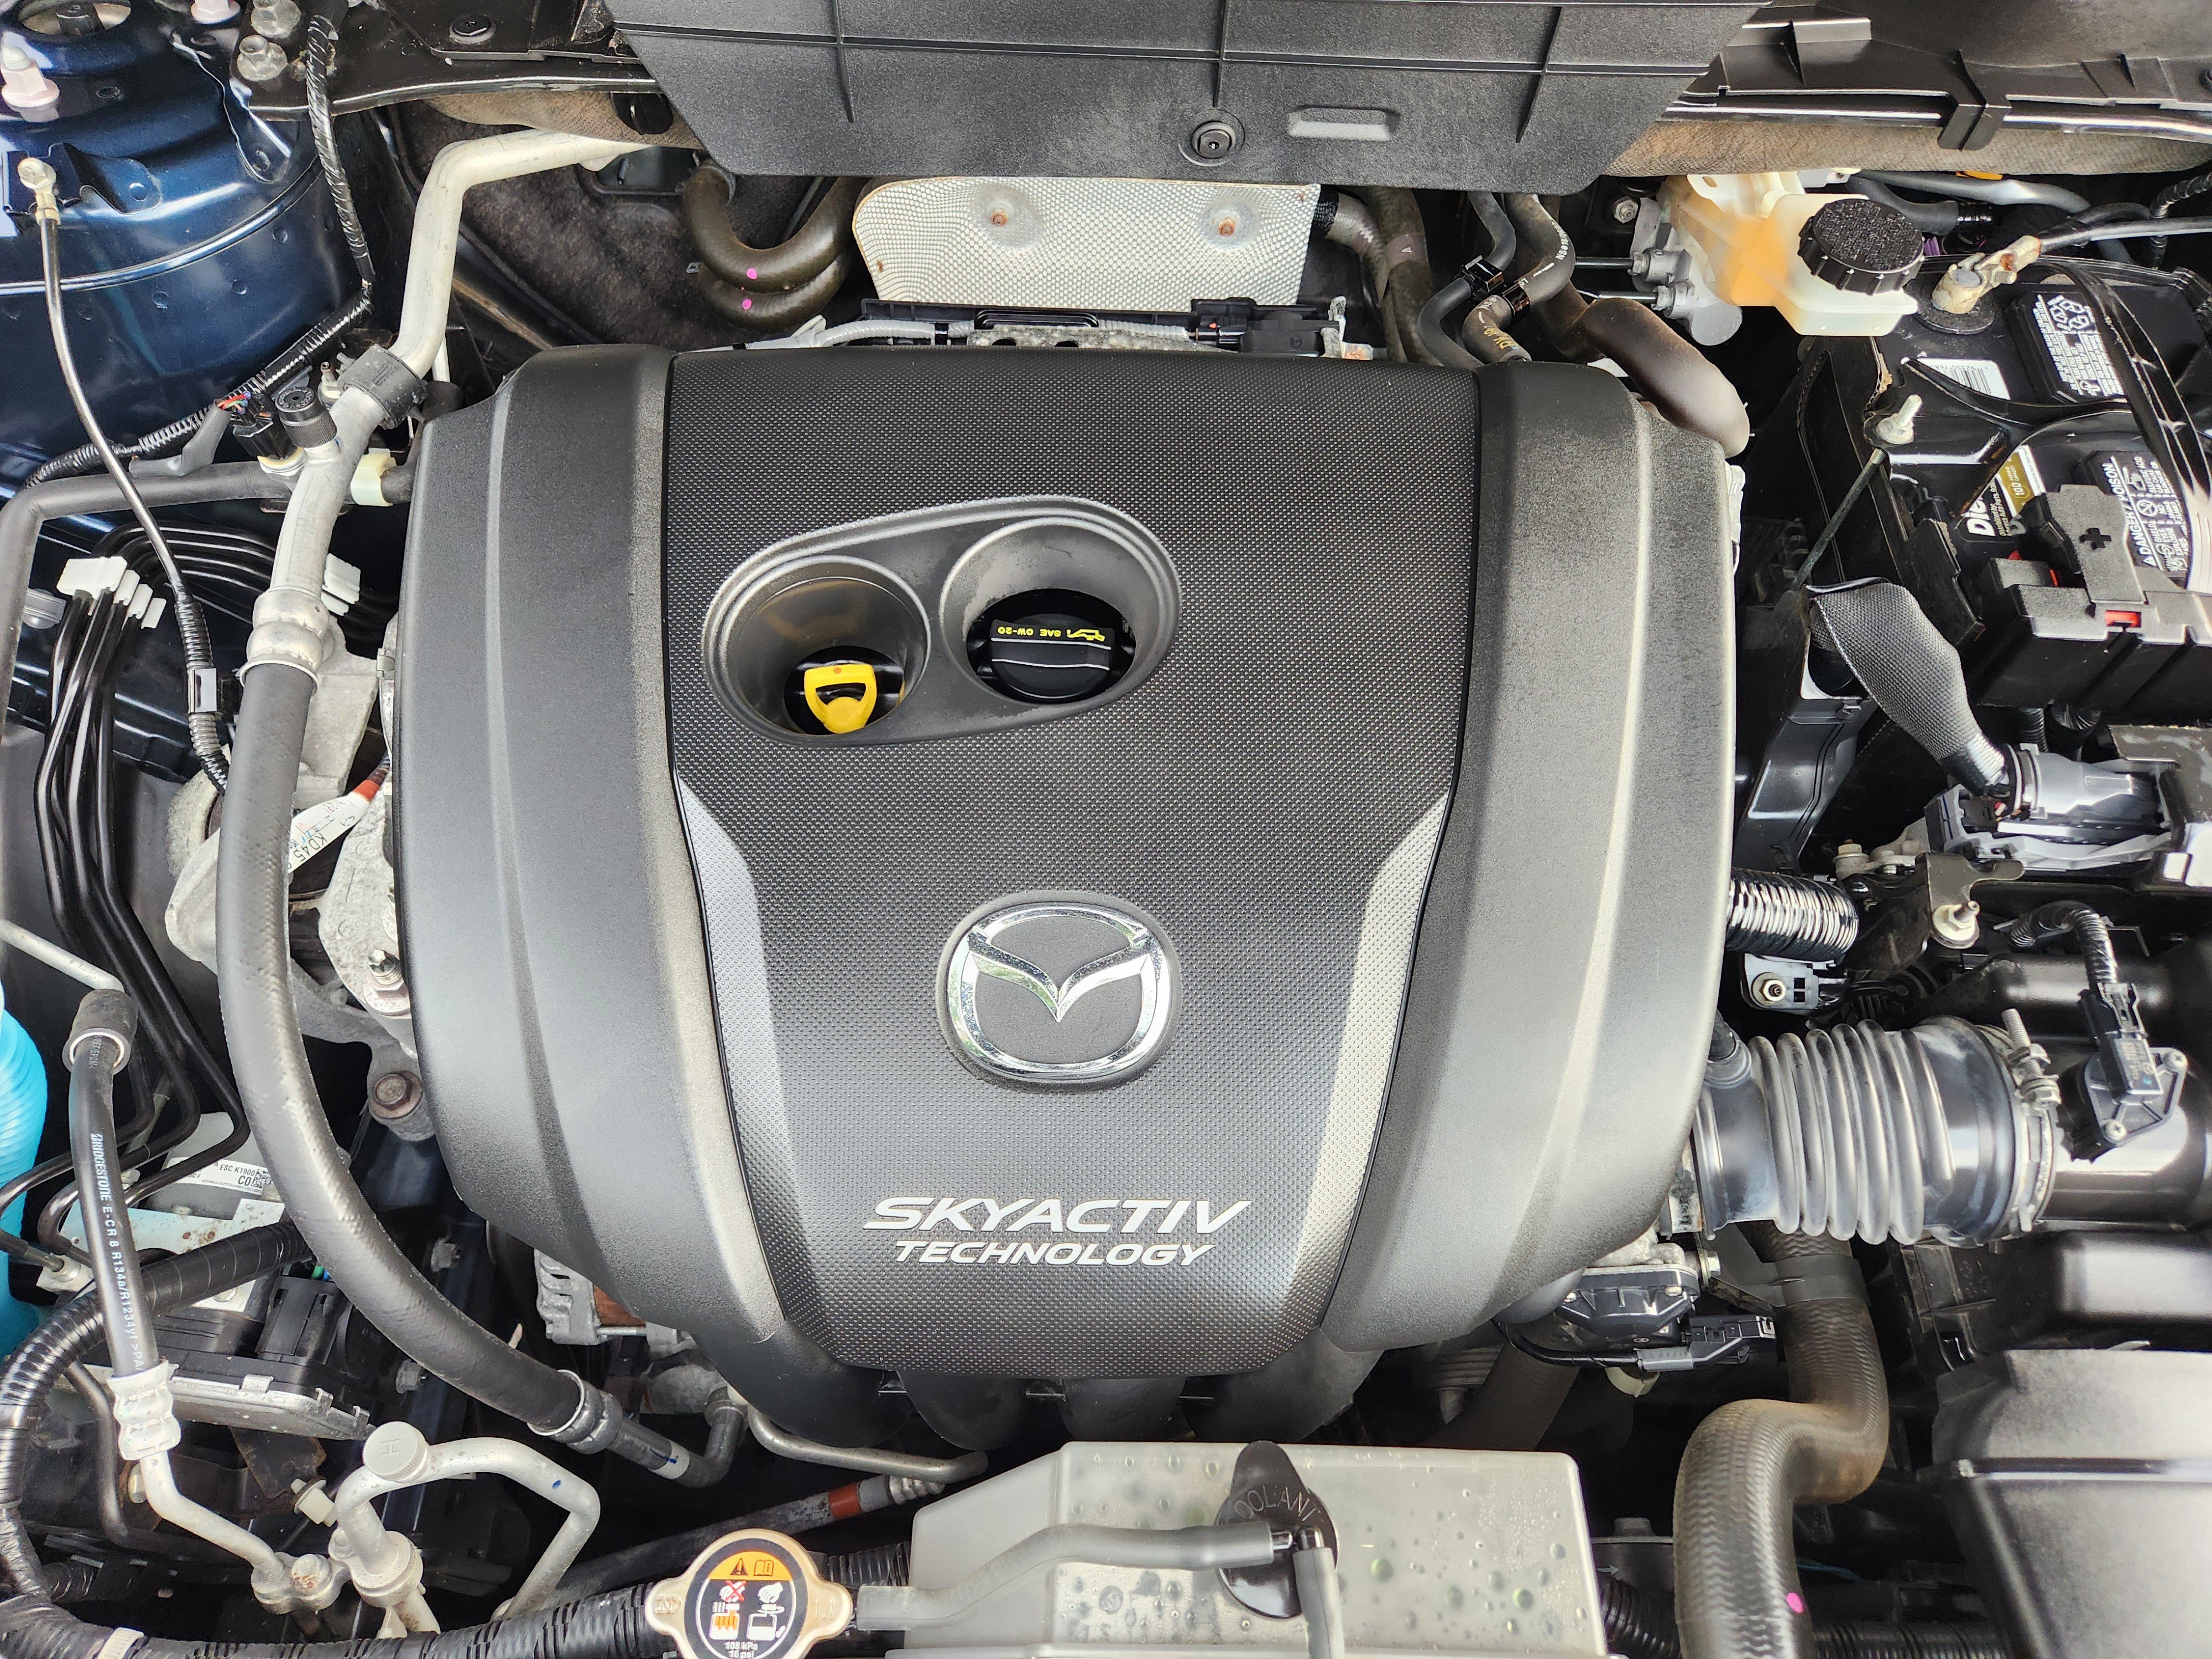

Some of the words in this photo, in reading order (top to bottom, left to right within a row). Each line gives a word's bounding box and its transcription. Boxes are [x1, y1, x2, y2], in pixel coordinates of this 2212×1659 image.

[2010, 482, 2025, 496] 100
[1963, 497, 1996, 536] Die
[997, 626, 1034, 636] 0W-20
[1039, 628, 1061, 637] SAE
[90, 1133, 112, 1201] BRIDGESTONE
[220, 1164, 233, 1172] ESC
[234, 1166, 255, 1176] K1900
[863, 1197, 1254, 1234] SKYACTIV
[895, 1240, 1215, 1267] TECHNOLOGY
[1229, 1485, 1321, 1523] OOLANT
[741, 1641, 758, 1650] kPa
